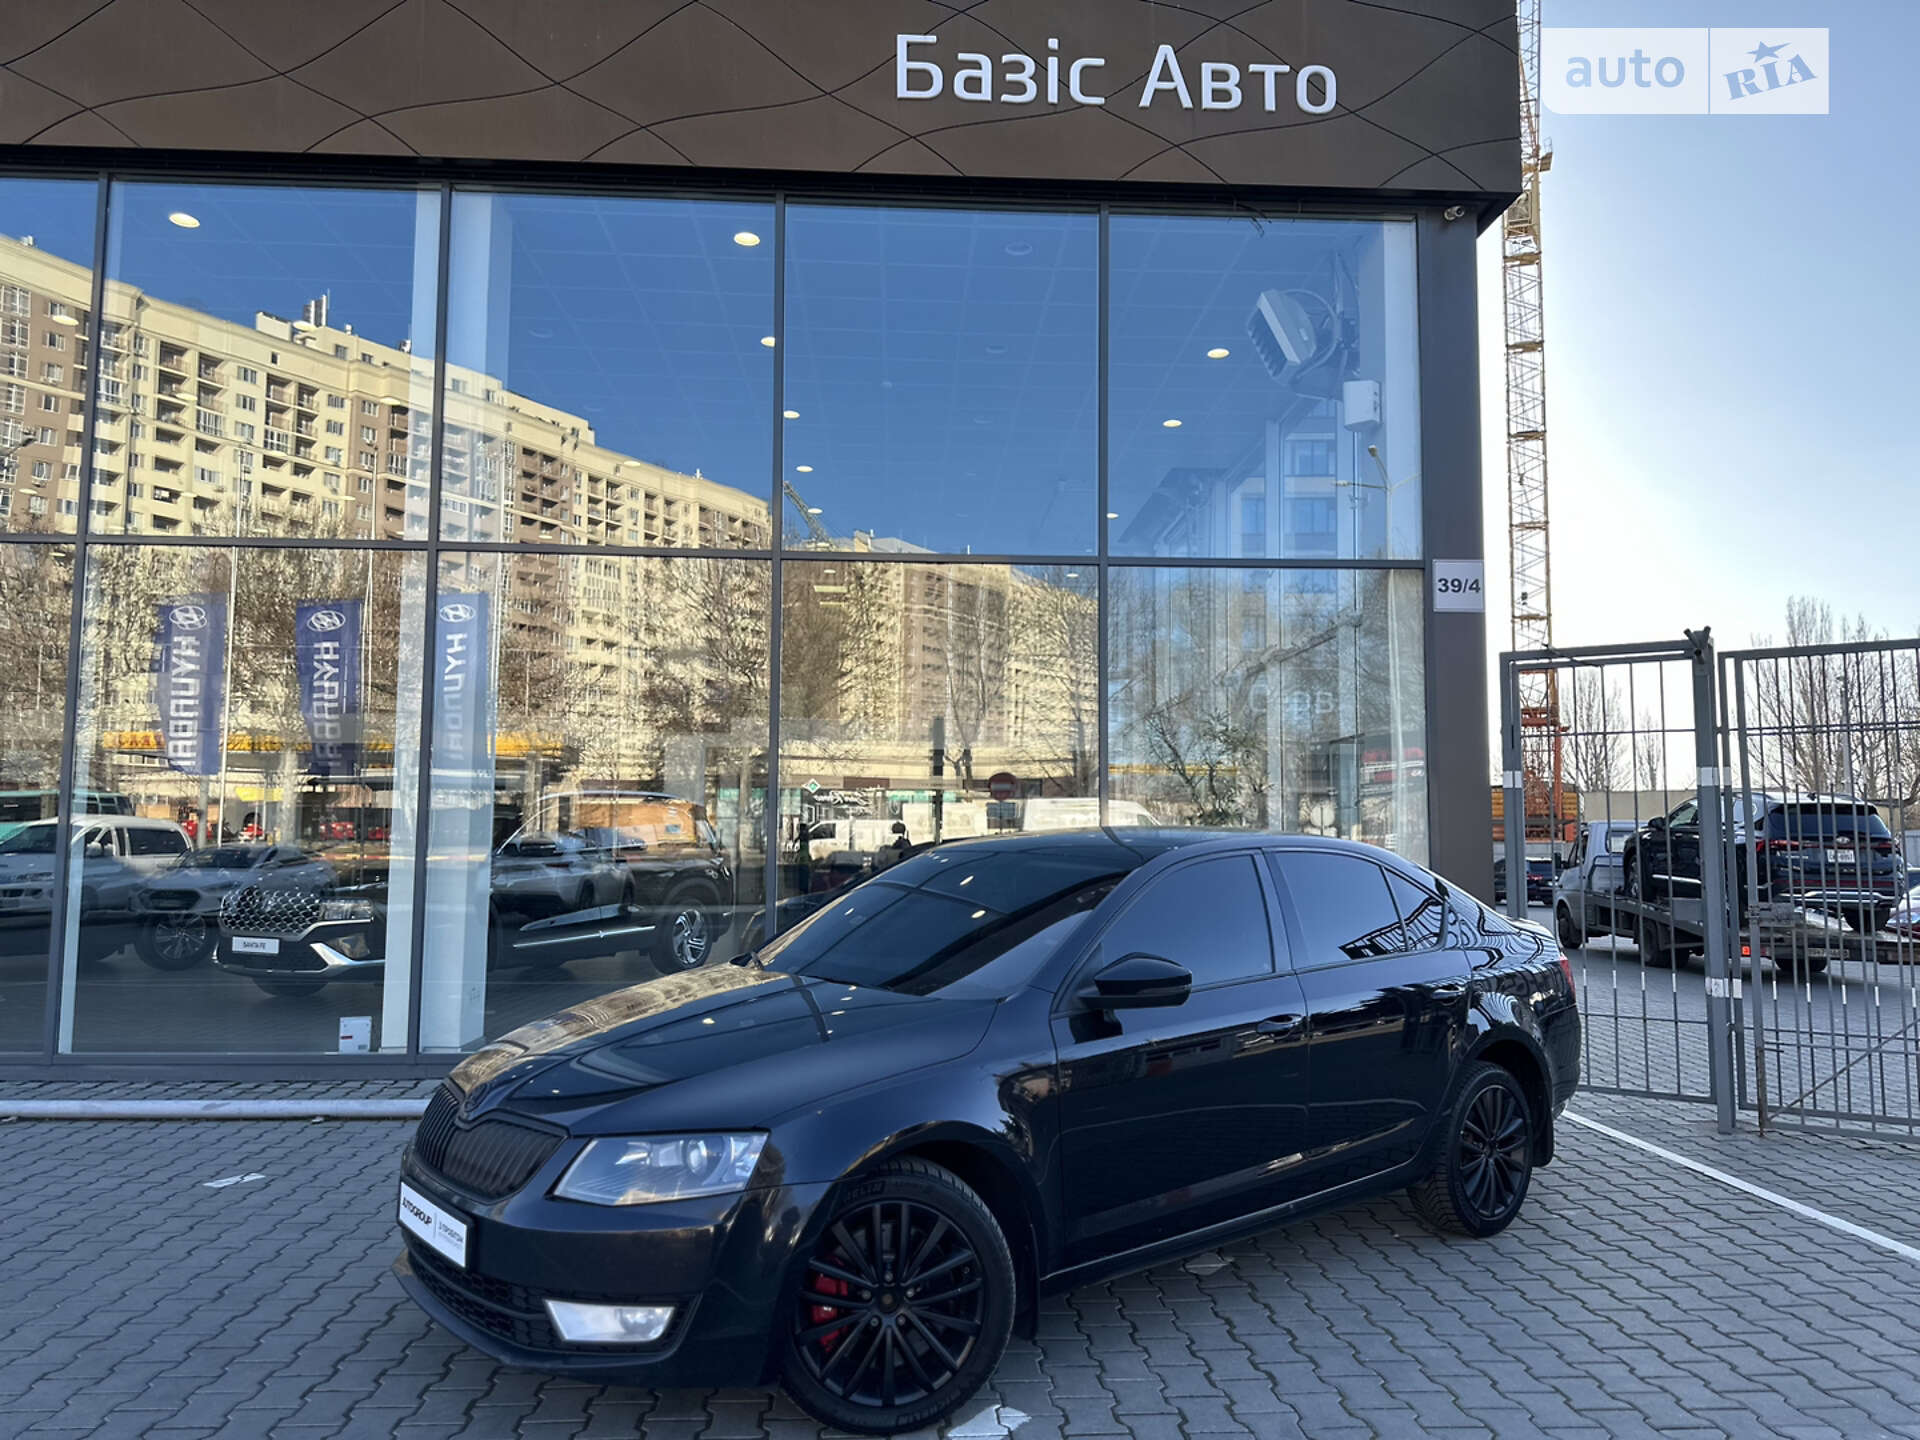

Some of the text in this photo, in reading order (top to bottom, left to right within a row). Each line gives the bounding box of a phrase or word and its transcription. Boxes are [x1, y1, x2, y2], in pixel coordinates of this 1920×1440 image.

[896, 33, 1338, 115] Базіс Авто
[1437, 577, 1481, 594] 39/4
